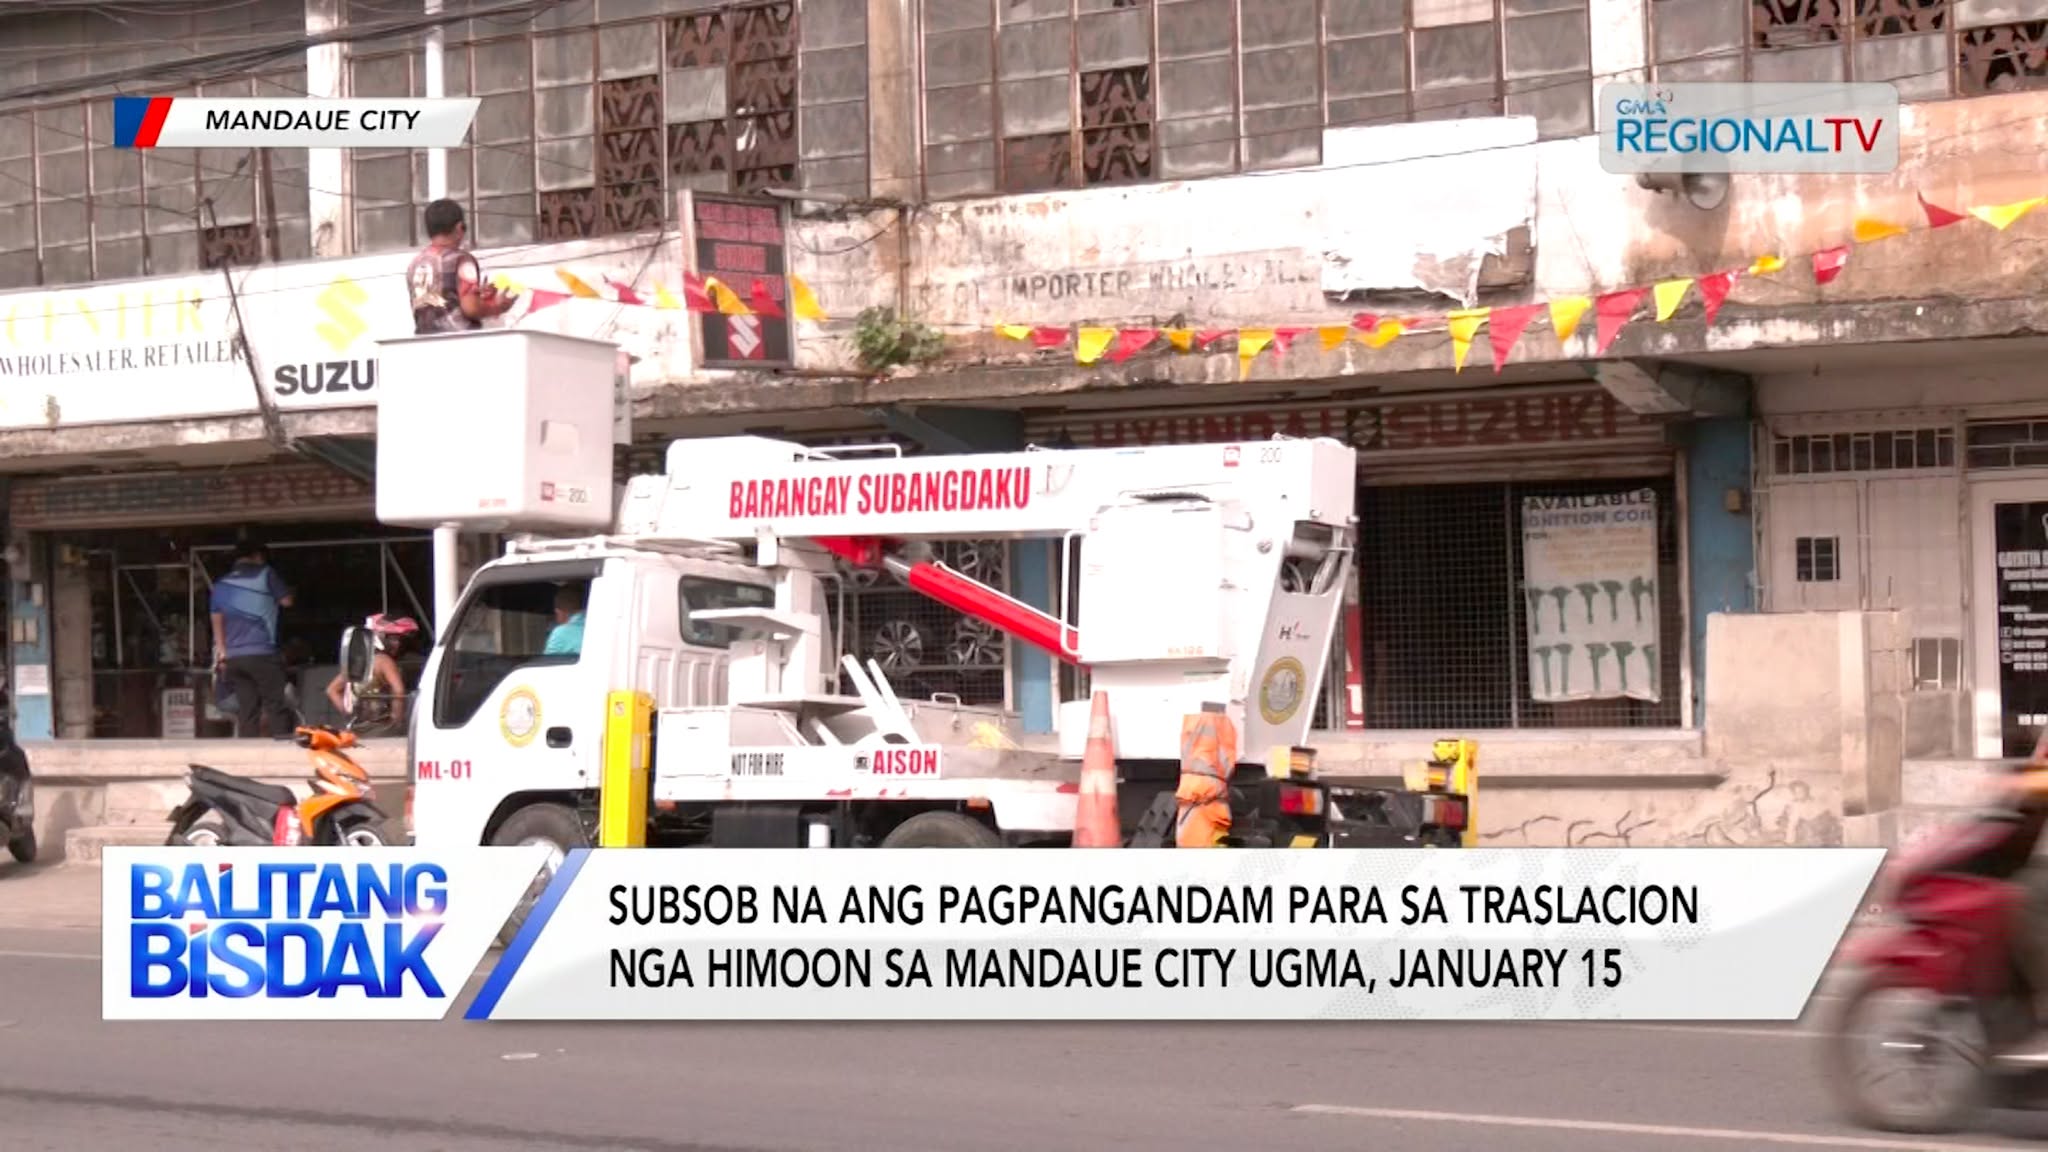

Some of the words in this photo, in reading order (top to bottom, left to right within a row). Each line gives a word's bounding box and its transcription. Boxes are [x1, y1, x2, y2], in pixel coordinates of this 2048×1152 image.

[1001, 270, 1132, 304] IMPORTER
[275, 358, 379, 397] SUZU
[1384, 393, 1618, 447] SUZUKI
[233, 471, 368, 506] TOYOT
[729, 475, 852, 519] BARANGAY
[857, 467, 1031, 515] SUBANGDAKU
[1526, 489, 1653, 510] AVAILABLE
[1525, 510, 1606, 528] IGNITION
[418, 760, 472, 780] ML-01
[731, 753, 747, 776] NOT
[749, 753, 763, 776] FOR
[766, 752, 784, 776] HIRE
[872, 749, 937, 775] AISON
